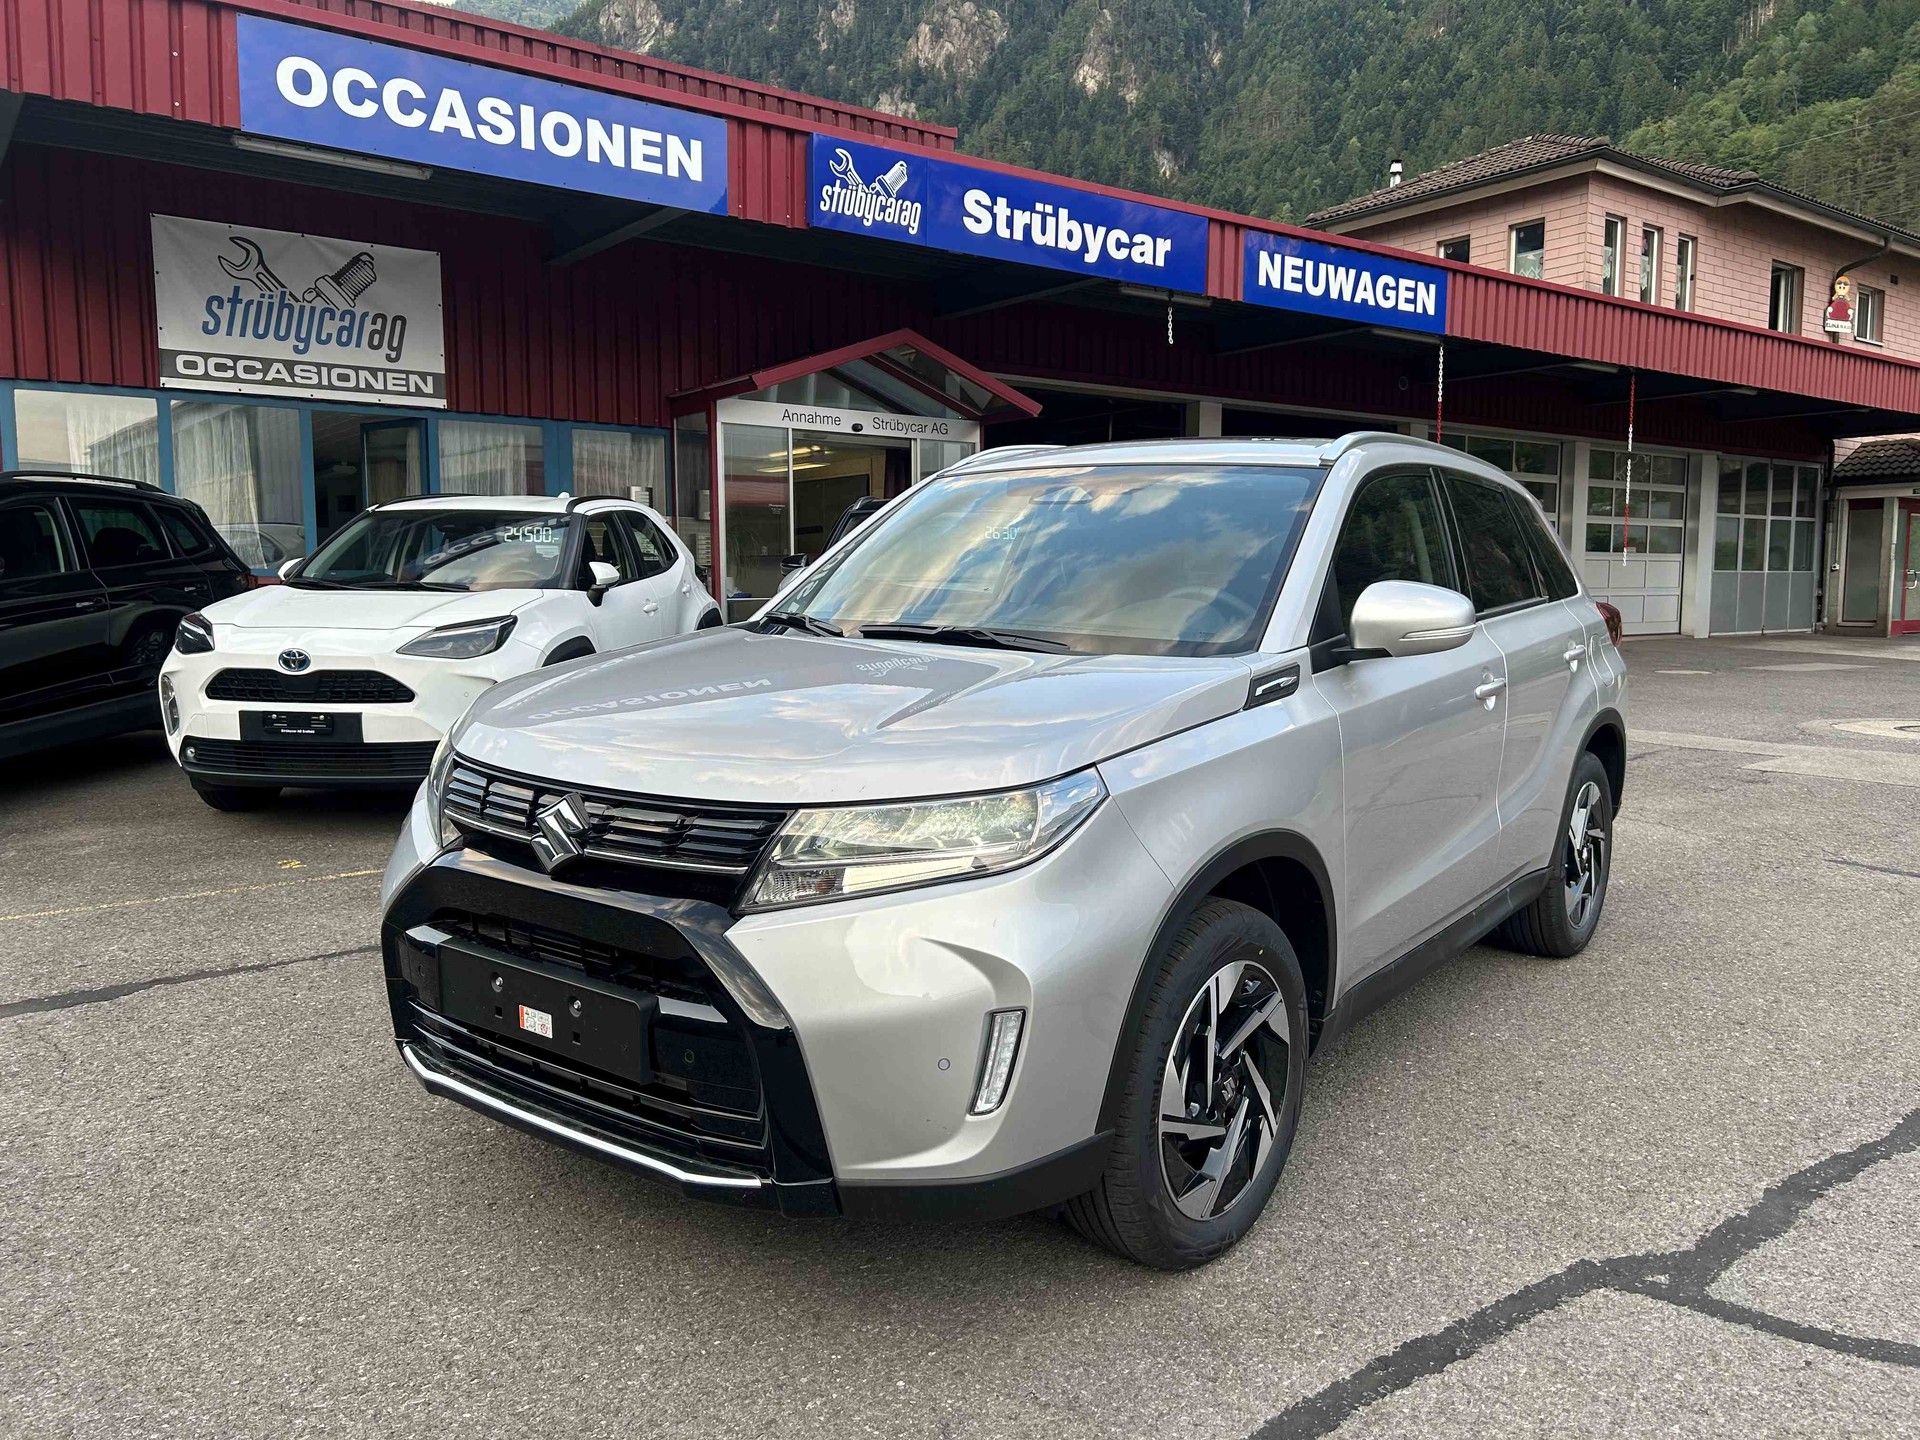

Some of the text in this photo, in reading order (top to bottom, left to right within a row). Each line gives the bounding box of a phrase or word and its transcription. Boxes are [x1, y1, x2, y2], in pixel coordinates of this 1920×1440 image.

[276, 56, 702, 182] OCCASIONEN
[820, 179, 922, 235] strübycarag
[962, 188, 1172, 267] Strübycar
[1257, 250, 1437, 316] NEUWAGEN
[202, 285, 407, 363] strübycarag
[174, 353, 434, 394] OCCASIONEN
[782, 408, 949, 439] Annahme Strübycar AG
